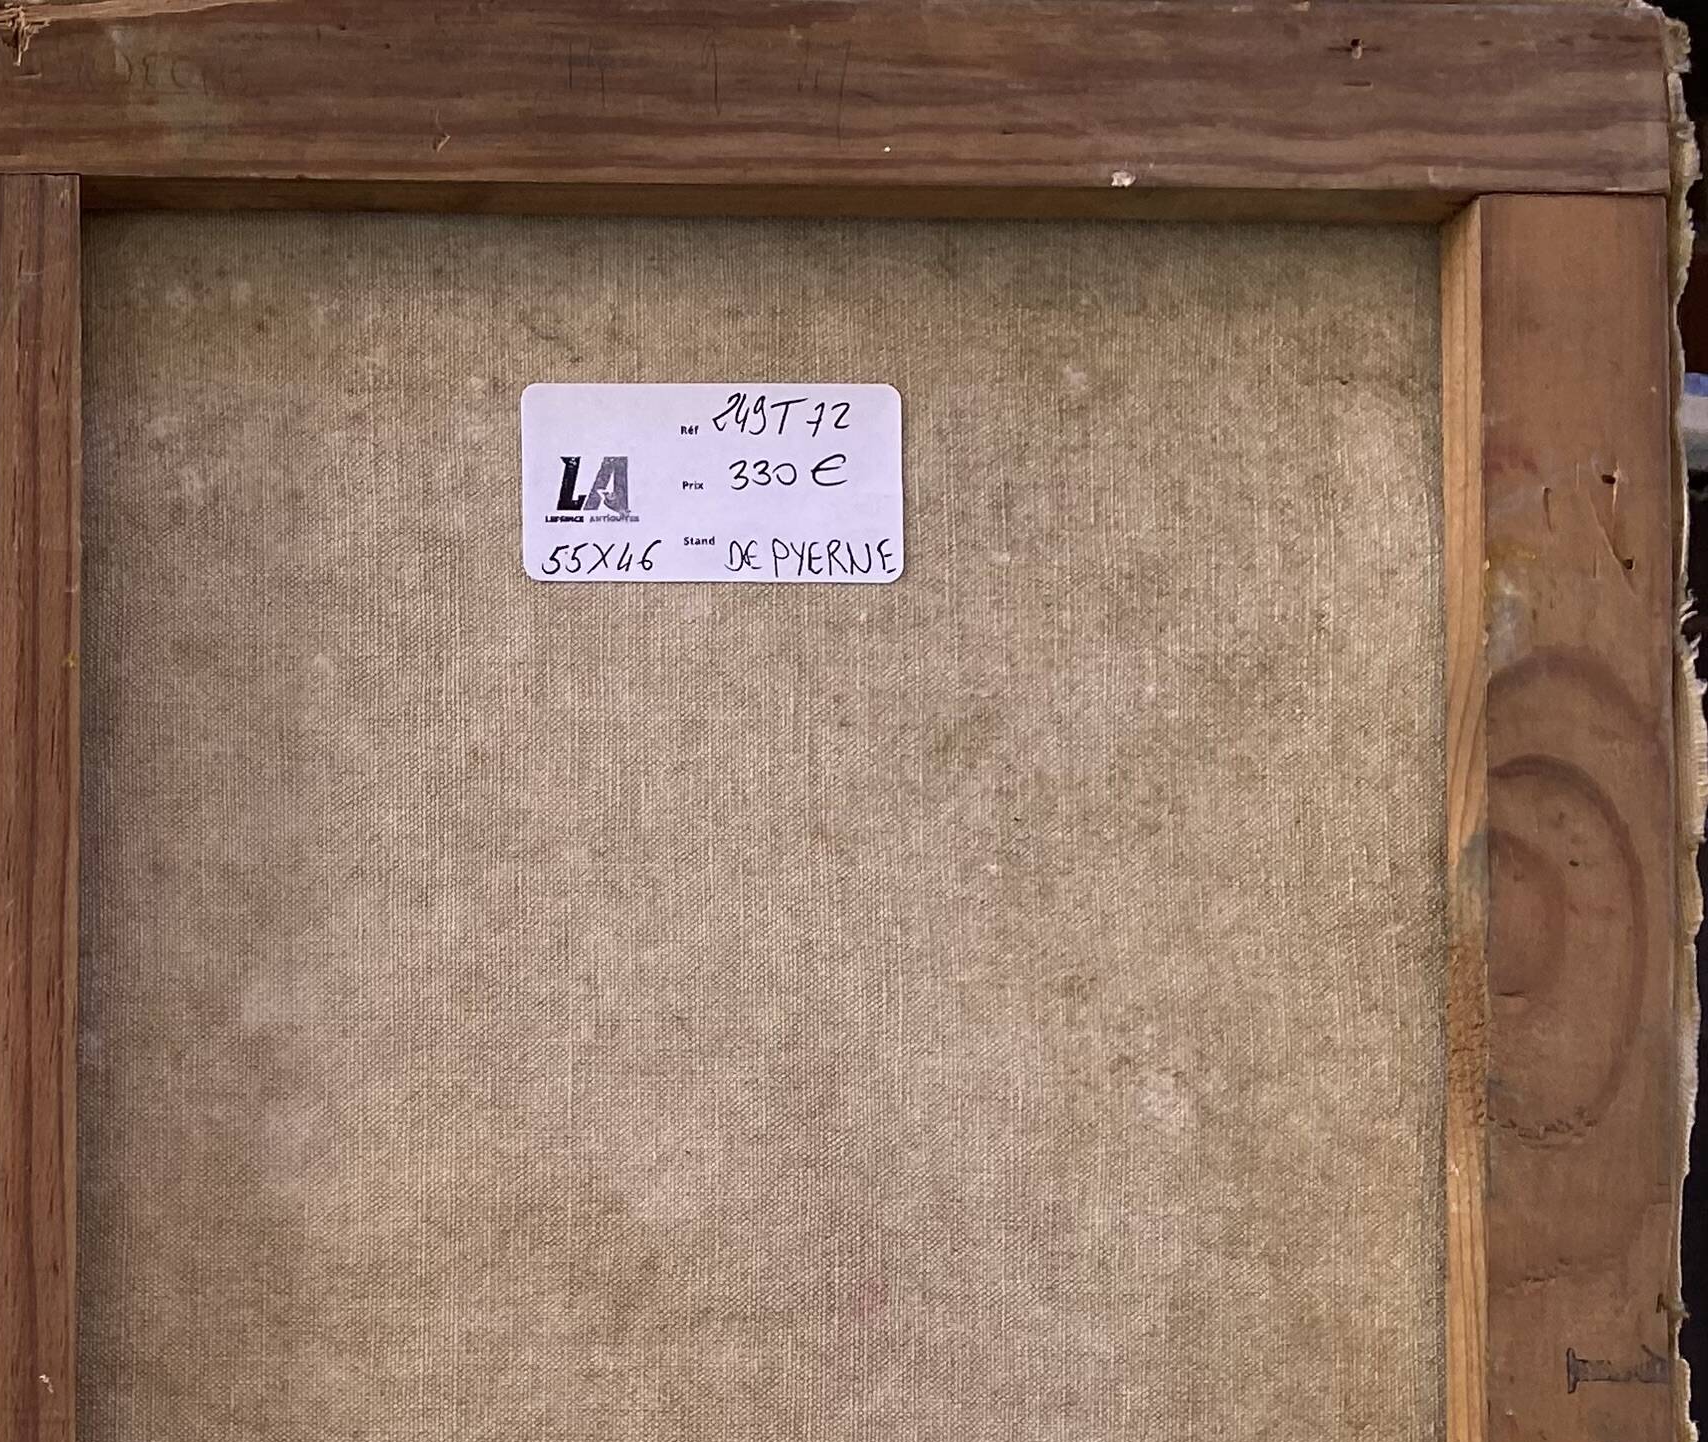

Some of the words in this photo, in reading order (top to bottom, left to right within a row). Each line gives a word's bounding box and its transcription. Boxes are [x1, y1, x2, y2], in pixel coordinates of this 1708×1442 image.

[680, 424, 700, 436] Réf
[556, 456, 629, 511] LA
[682, 480, 704, 490] Prix
[683, 535, 716, 546] Stand
